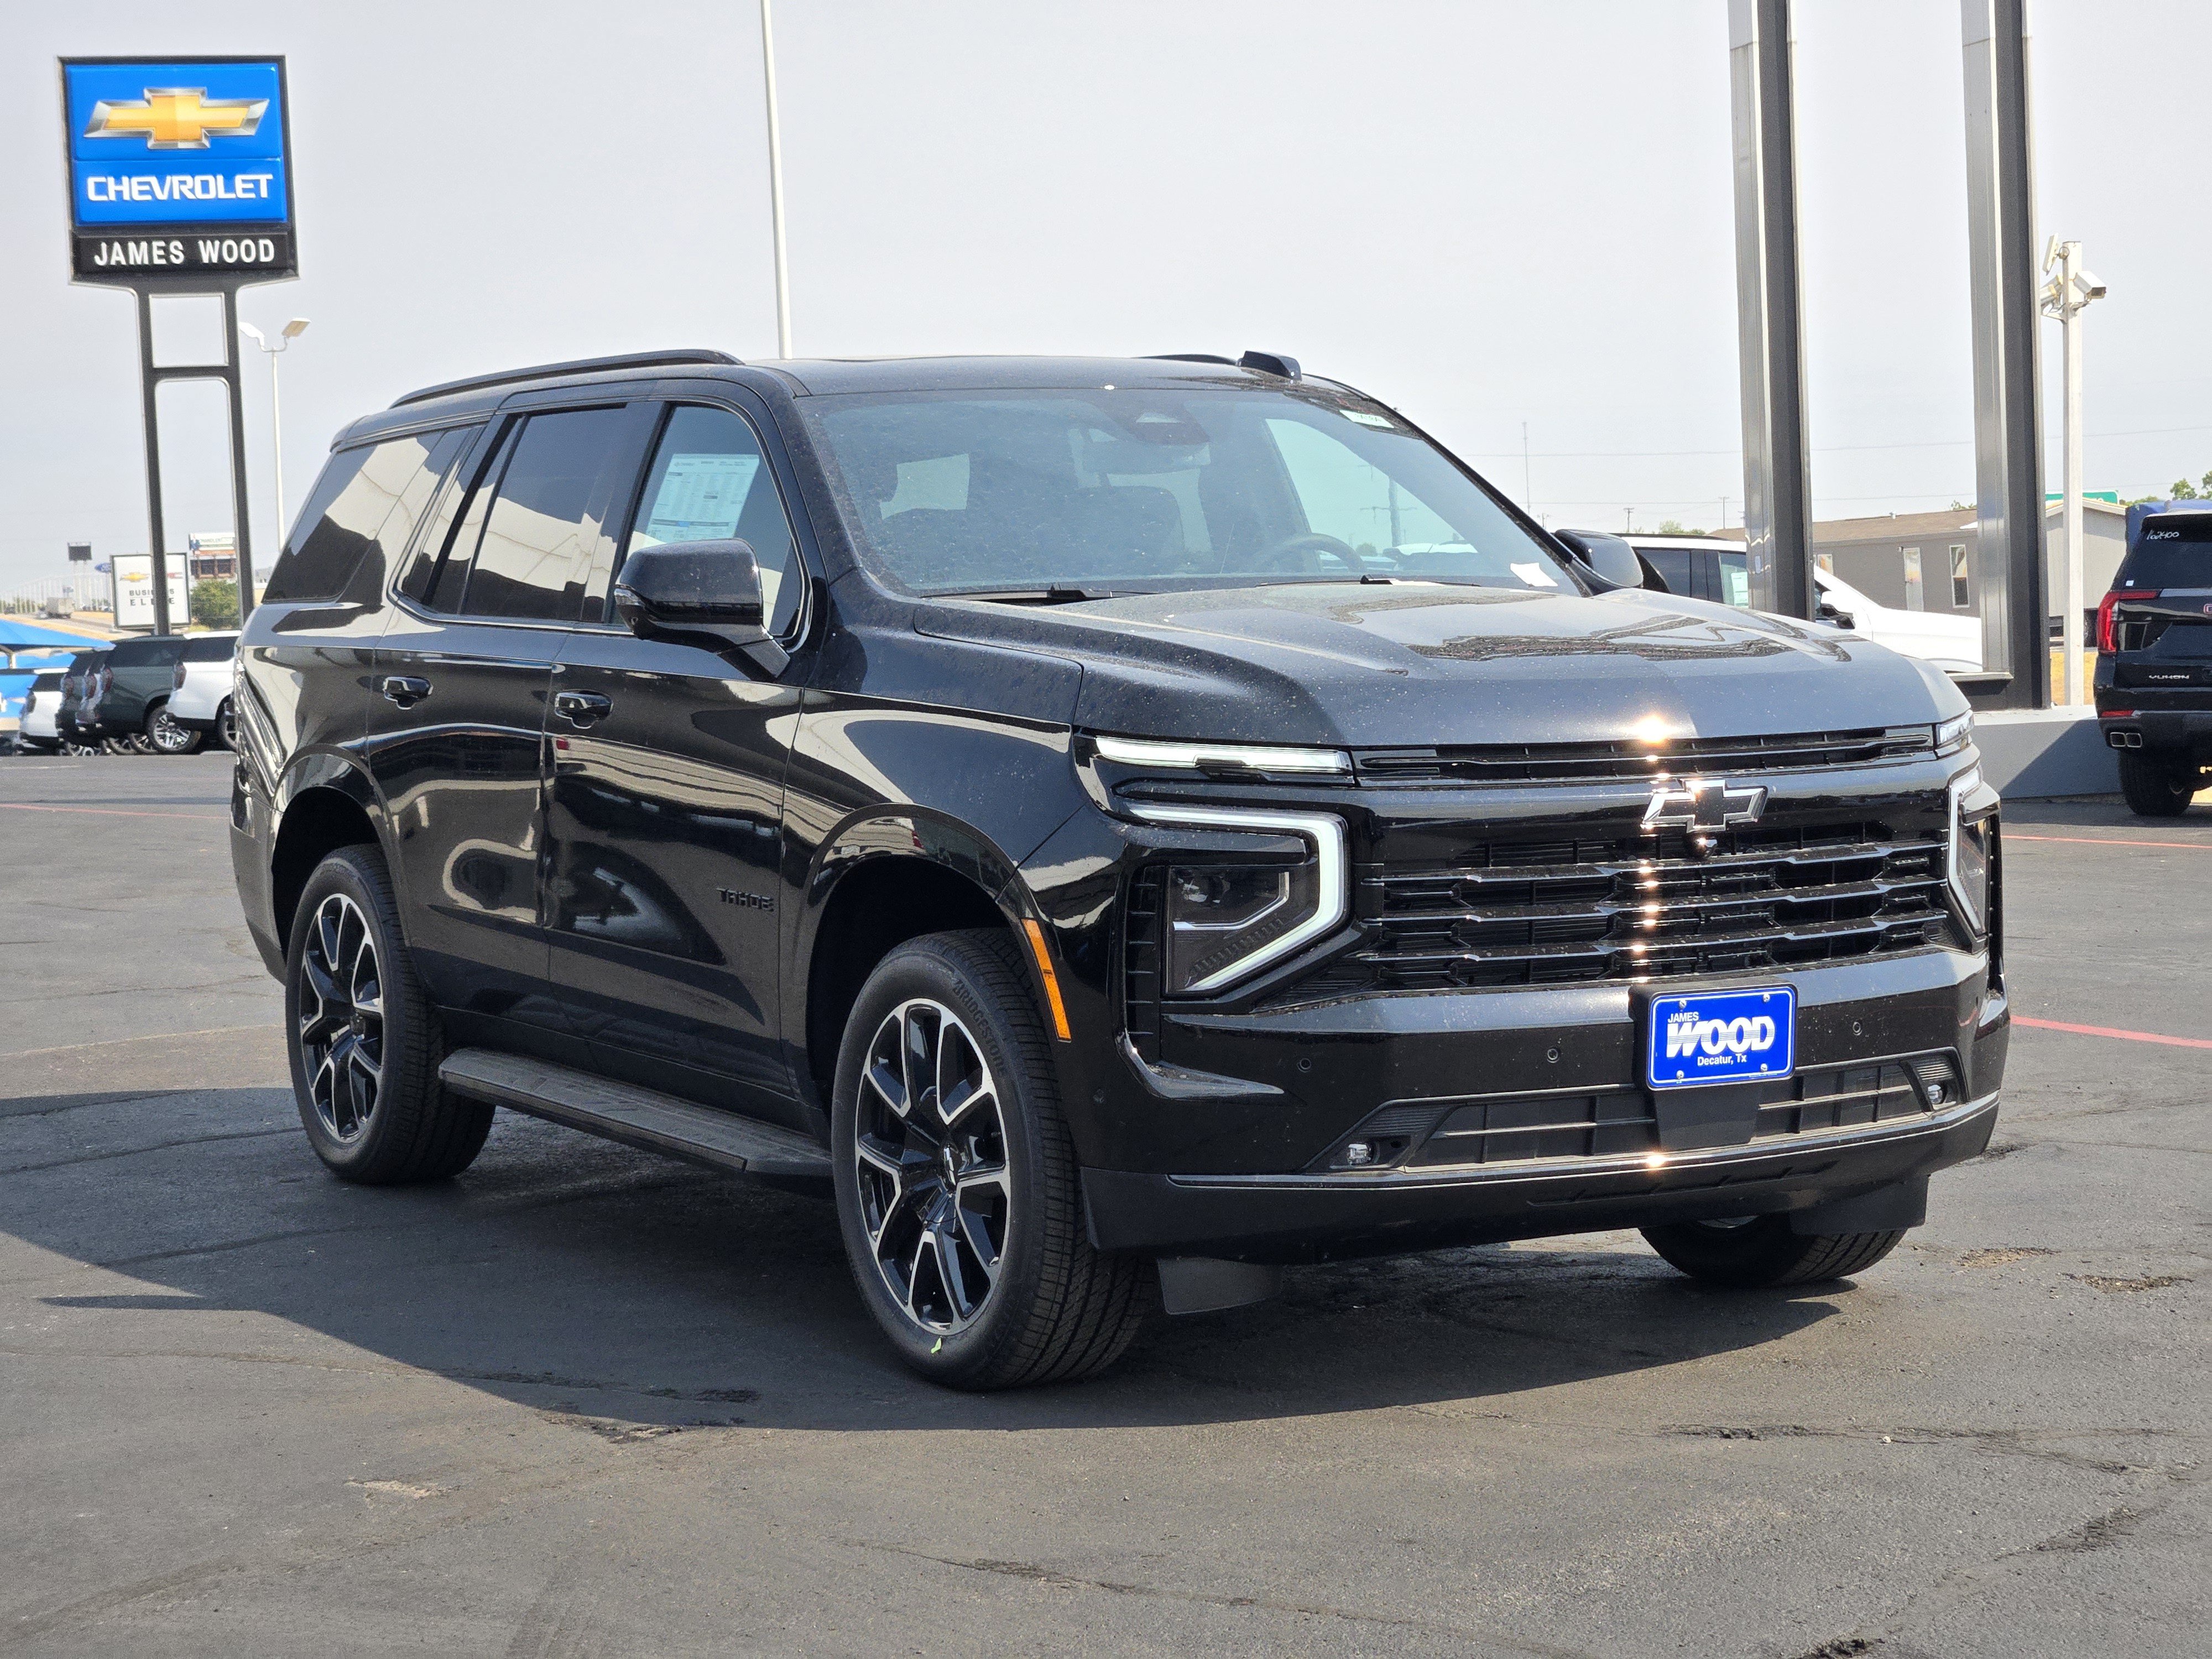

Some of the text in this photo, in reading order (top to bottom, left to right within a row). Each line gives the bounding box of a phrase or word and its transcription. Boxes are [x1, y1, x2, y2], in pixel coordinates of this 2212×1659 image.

[87, 174, 273, 201] CHEVROLET
[93, 238, 275, 266] JAMES WOOD
[716, 888, 774, 912] TAHOE
[951, 978, 1009, 1075] BRIDGESTONE
[1667, 1011, 1699, 1023] JAMES
[1666, 1016, 1775, 1058] WOOD
[1697, 1053, 1747, 1066] Decatur, Tx
